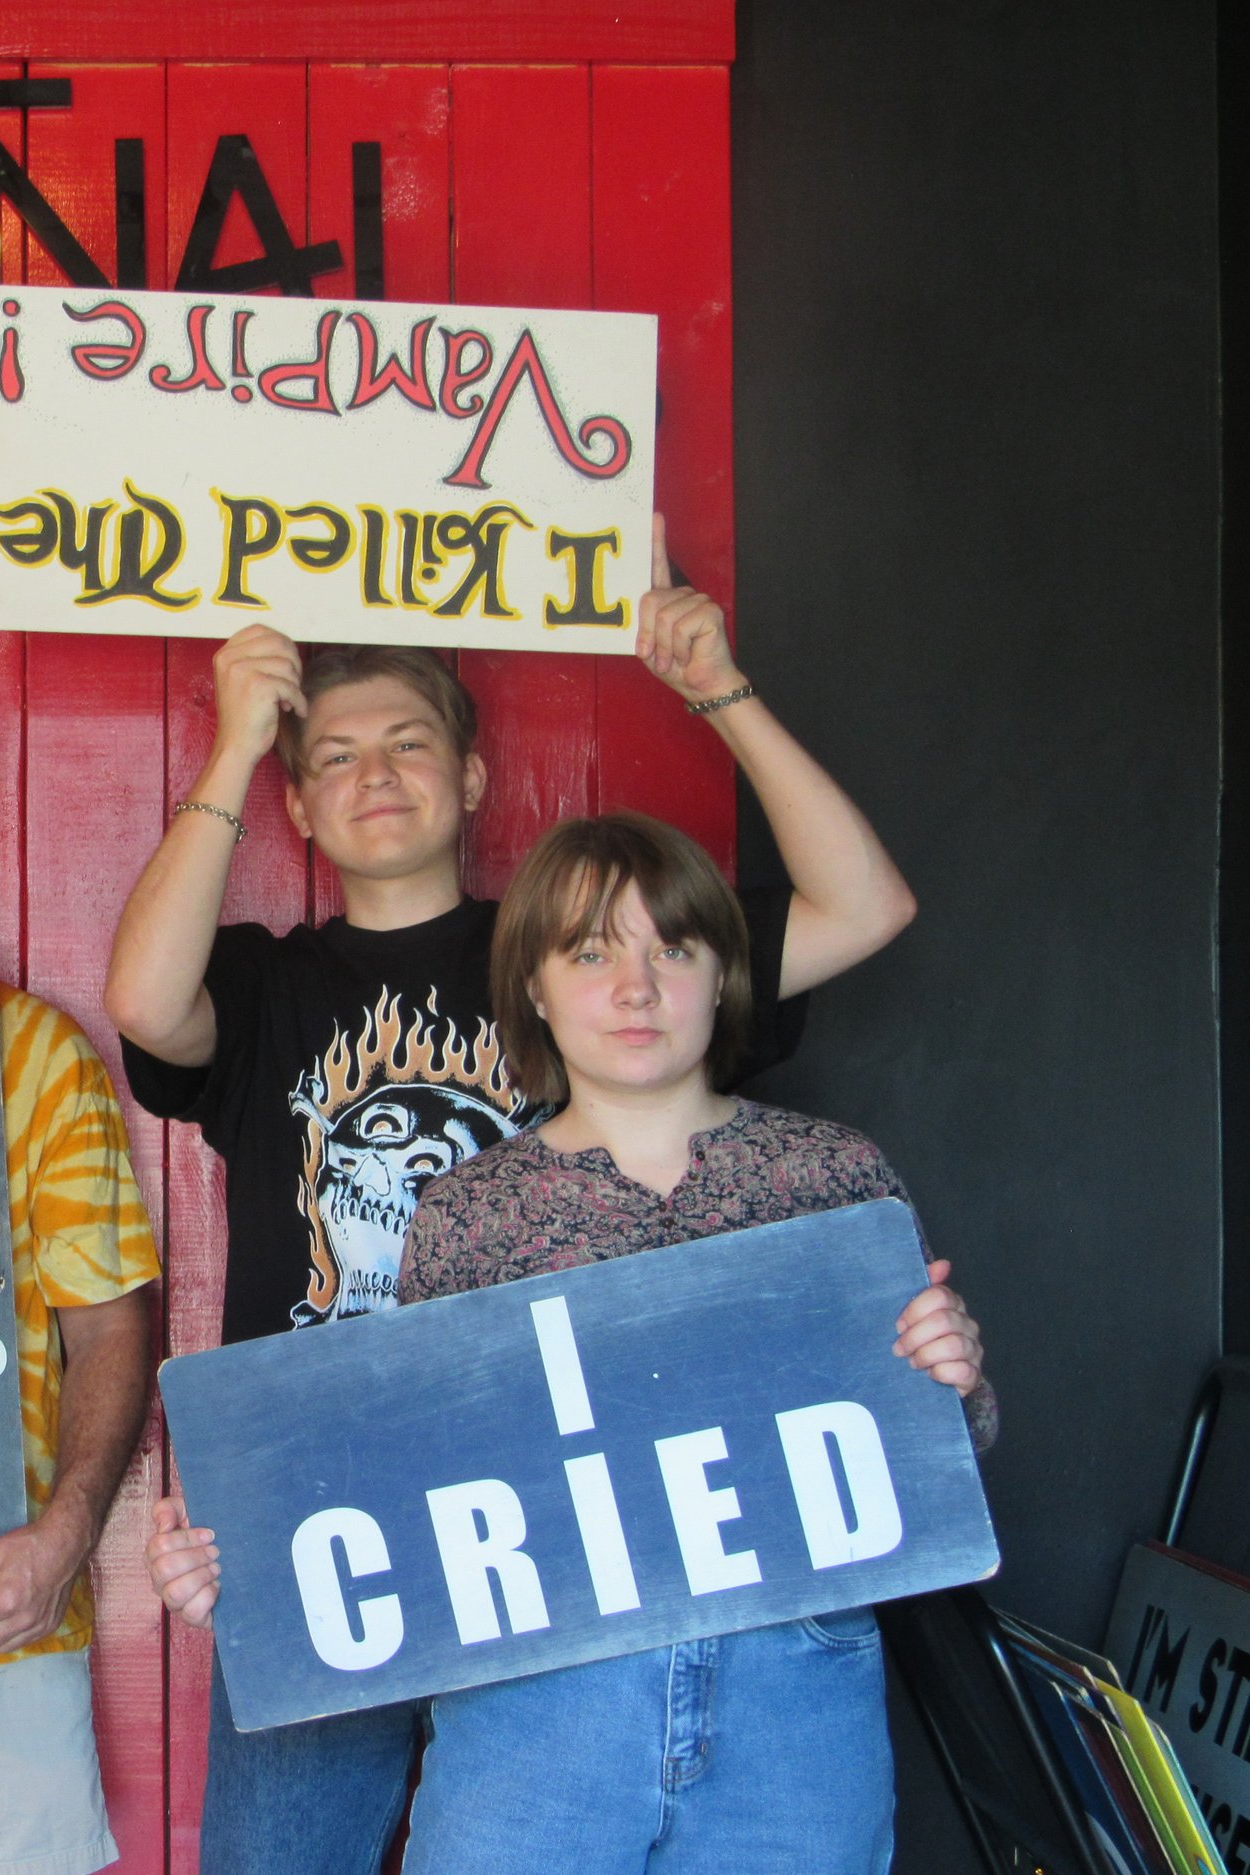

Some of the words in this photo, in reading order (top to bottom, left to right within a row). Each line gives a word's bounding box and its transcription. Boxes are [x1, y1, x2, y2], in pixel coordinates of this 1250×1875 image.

[209, 487, 533, 622] Killed
[543, 526, 629, 628] I
[529, 1295, 595, 1436] I
[290, 1401, 904, 1671] CRIED
[1125, 1604, 1191, 1713] I'M
